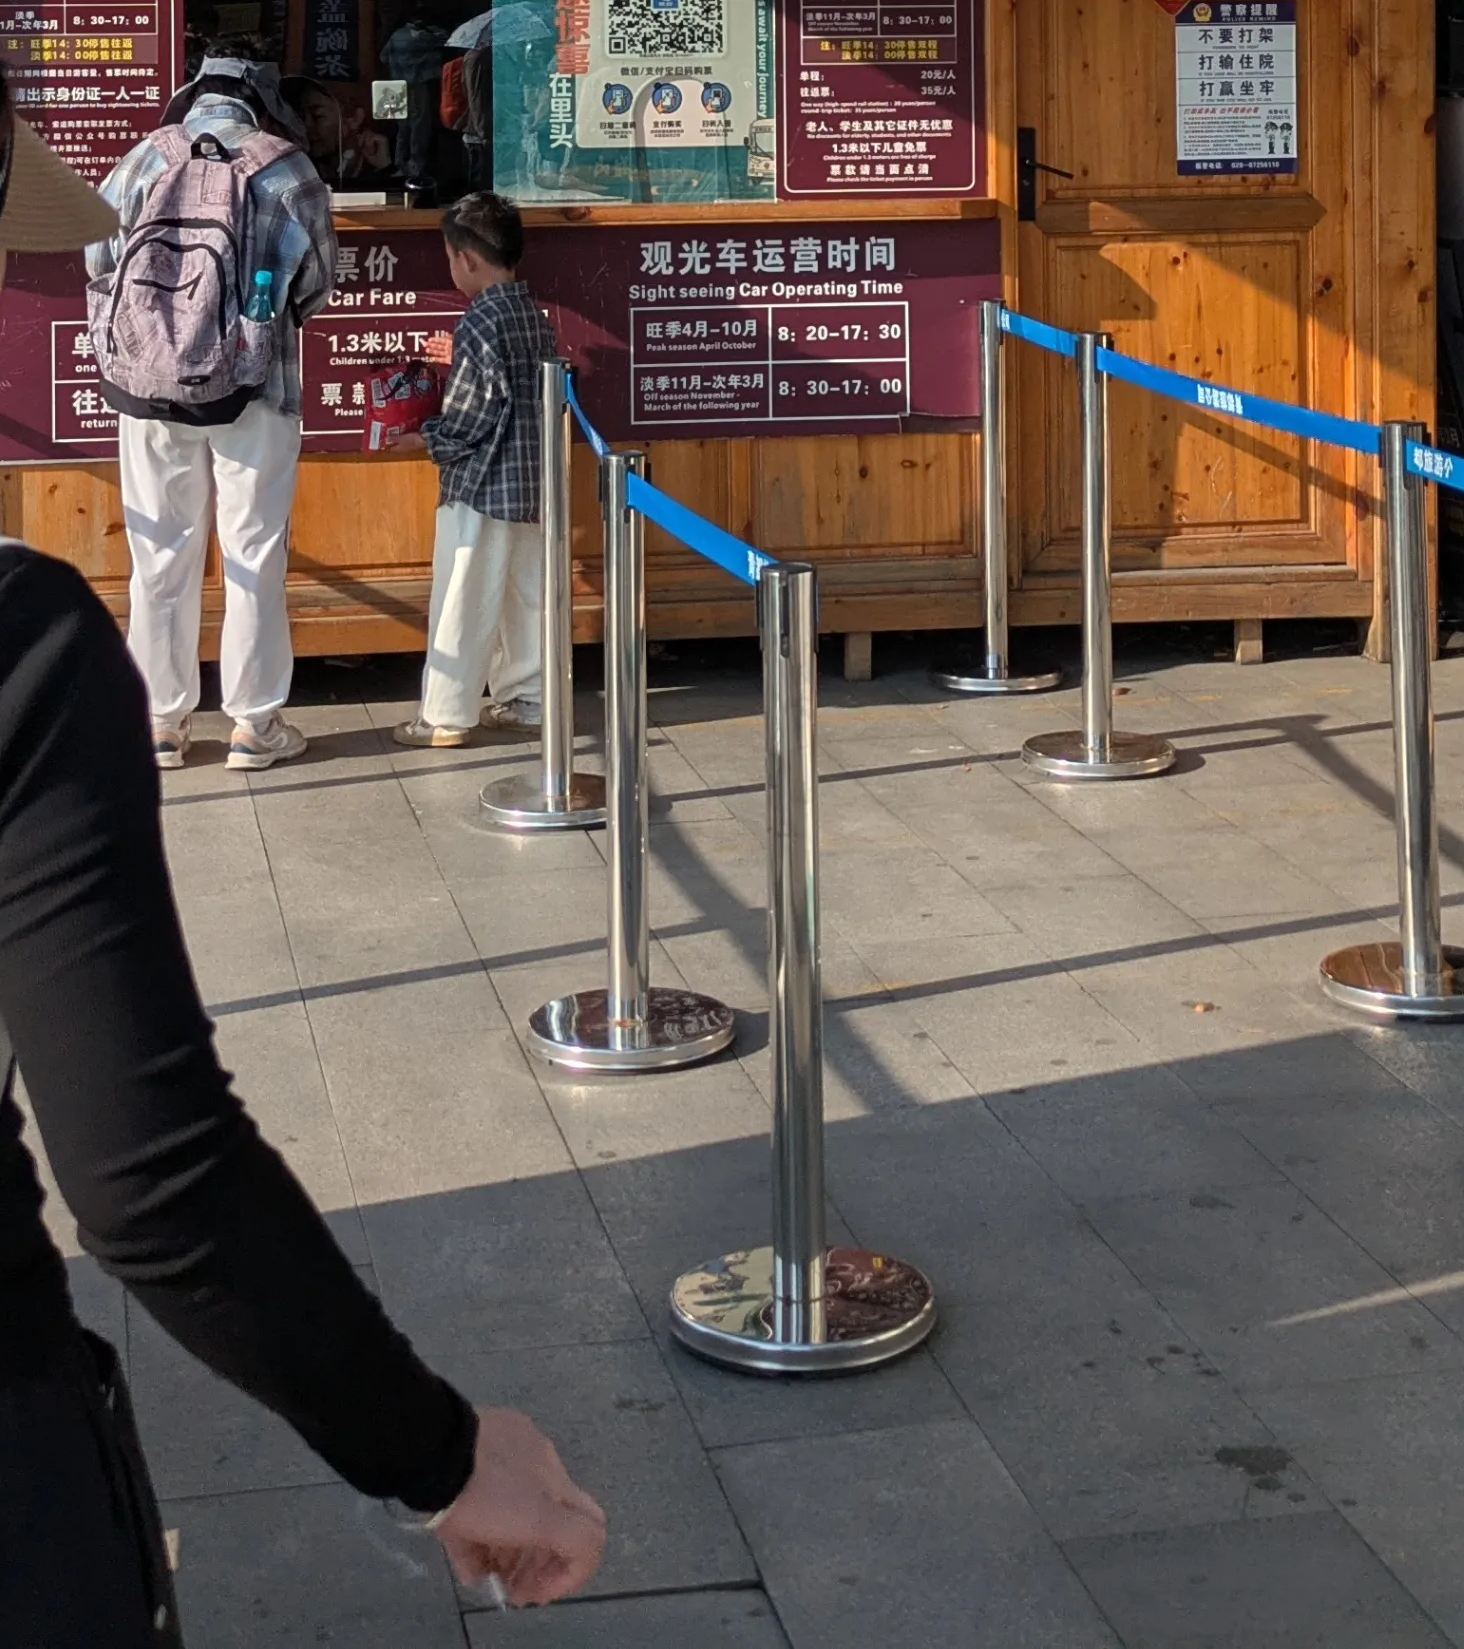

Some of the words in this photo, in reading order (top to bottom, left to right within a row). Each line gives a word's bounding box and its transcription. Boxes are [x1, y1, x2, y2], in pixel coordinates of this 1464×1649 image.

[1220, 3, 1279, 17] 警察提醒
[1198, 29, 1274, 44] 不要打架
[1198, 53, 1275, 71] 打输住院
[921, 70, 956, 79] 20元/人
[921, 86, 956, 95] 35元/人
[1200, 80, 1275, 97] 打赢坐牢
[832, 142, 927, 153] 1.3米以下儿童免票
[640, 237, 896, 275] 观光车运营时间
[335, 245, 398, 283] 票价
[328, 289, 364, 306] Car
[370, 288, 417, 306] Fare
[629, 284, 675, 302] Sight
[679, 285, 735, 300] seeing
[739, 282, 768, 297] Car
[772, 281, 857, 299] Operating
[861, 280, 903, 294] Time
[646, 319, 758, 339] 旺季4月-10月
[72, 332, 94, 358] 单
[646, 343, 663, 351] Peak
[665, 343, 697, 351] season
[699, 342, 719, 352] April
[722, 341, 756, 349] October
[329, 357, 367, 365] Children
[75, 364, 97, 373] one
[640, 373, 764, 392] 淡季11月-次年3月
[690, 391, 735, 399] November
[644, 402, 666, 411] March
[683, 402, 696, 410] the
[698, 401, 736, 411] following
[739, 402, 759, 411] year
[81, 419, 117, 428] return
